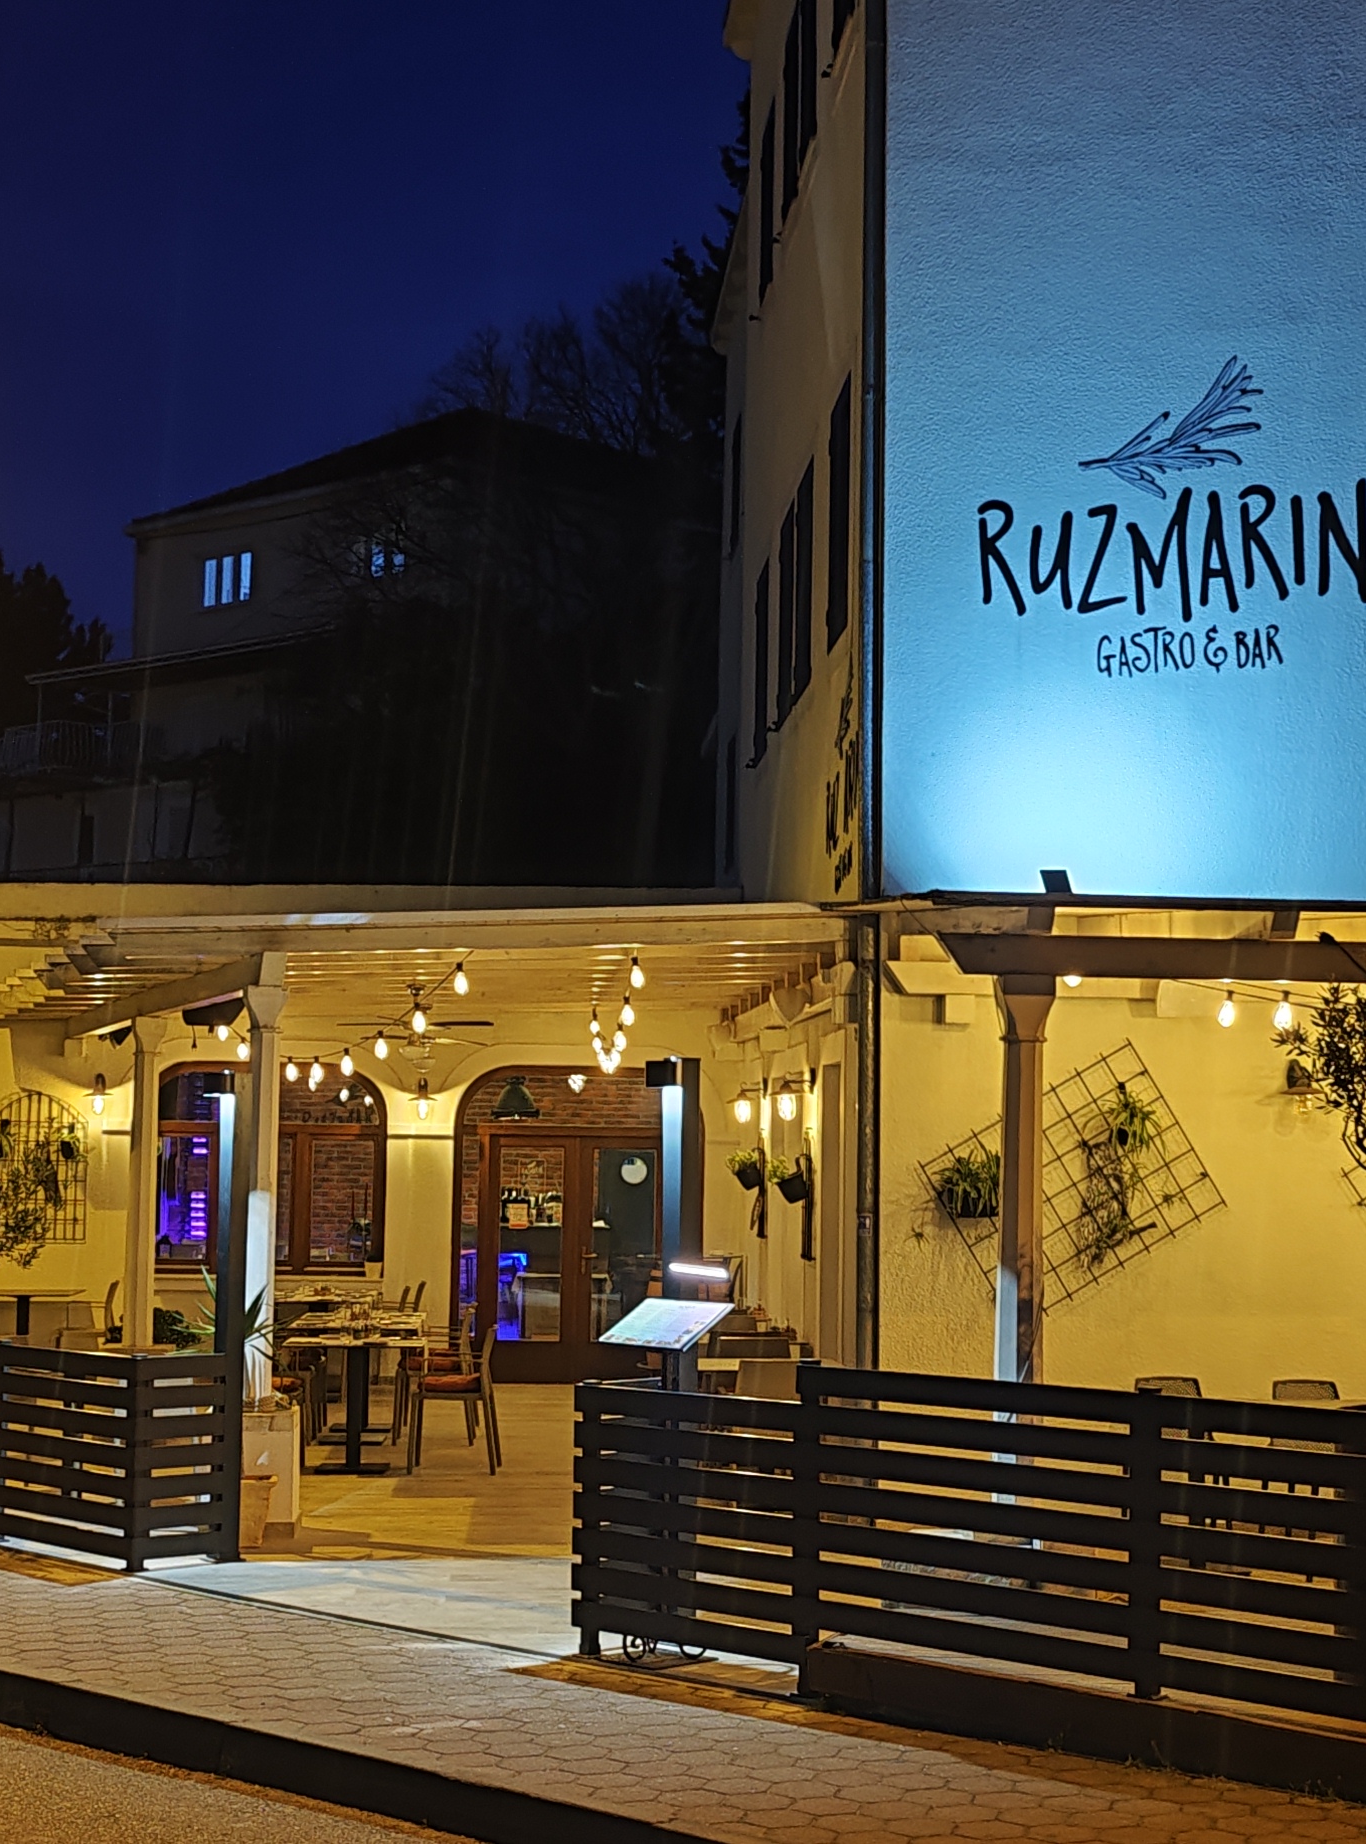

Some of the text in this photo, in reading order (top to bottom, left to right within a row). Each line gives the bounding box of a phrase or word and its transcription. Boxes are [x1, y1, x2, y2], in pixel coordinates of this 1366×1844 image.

[1097, 624, 1284, 677] GASTRO & BAR
